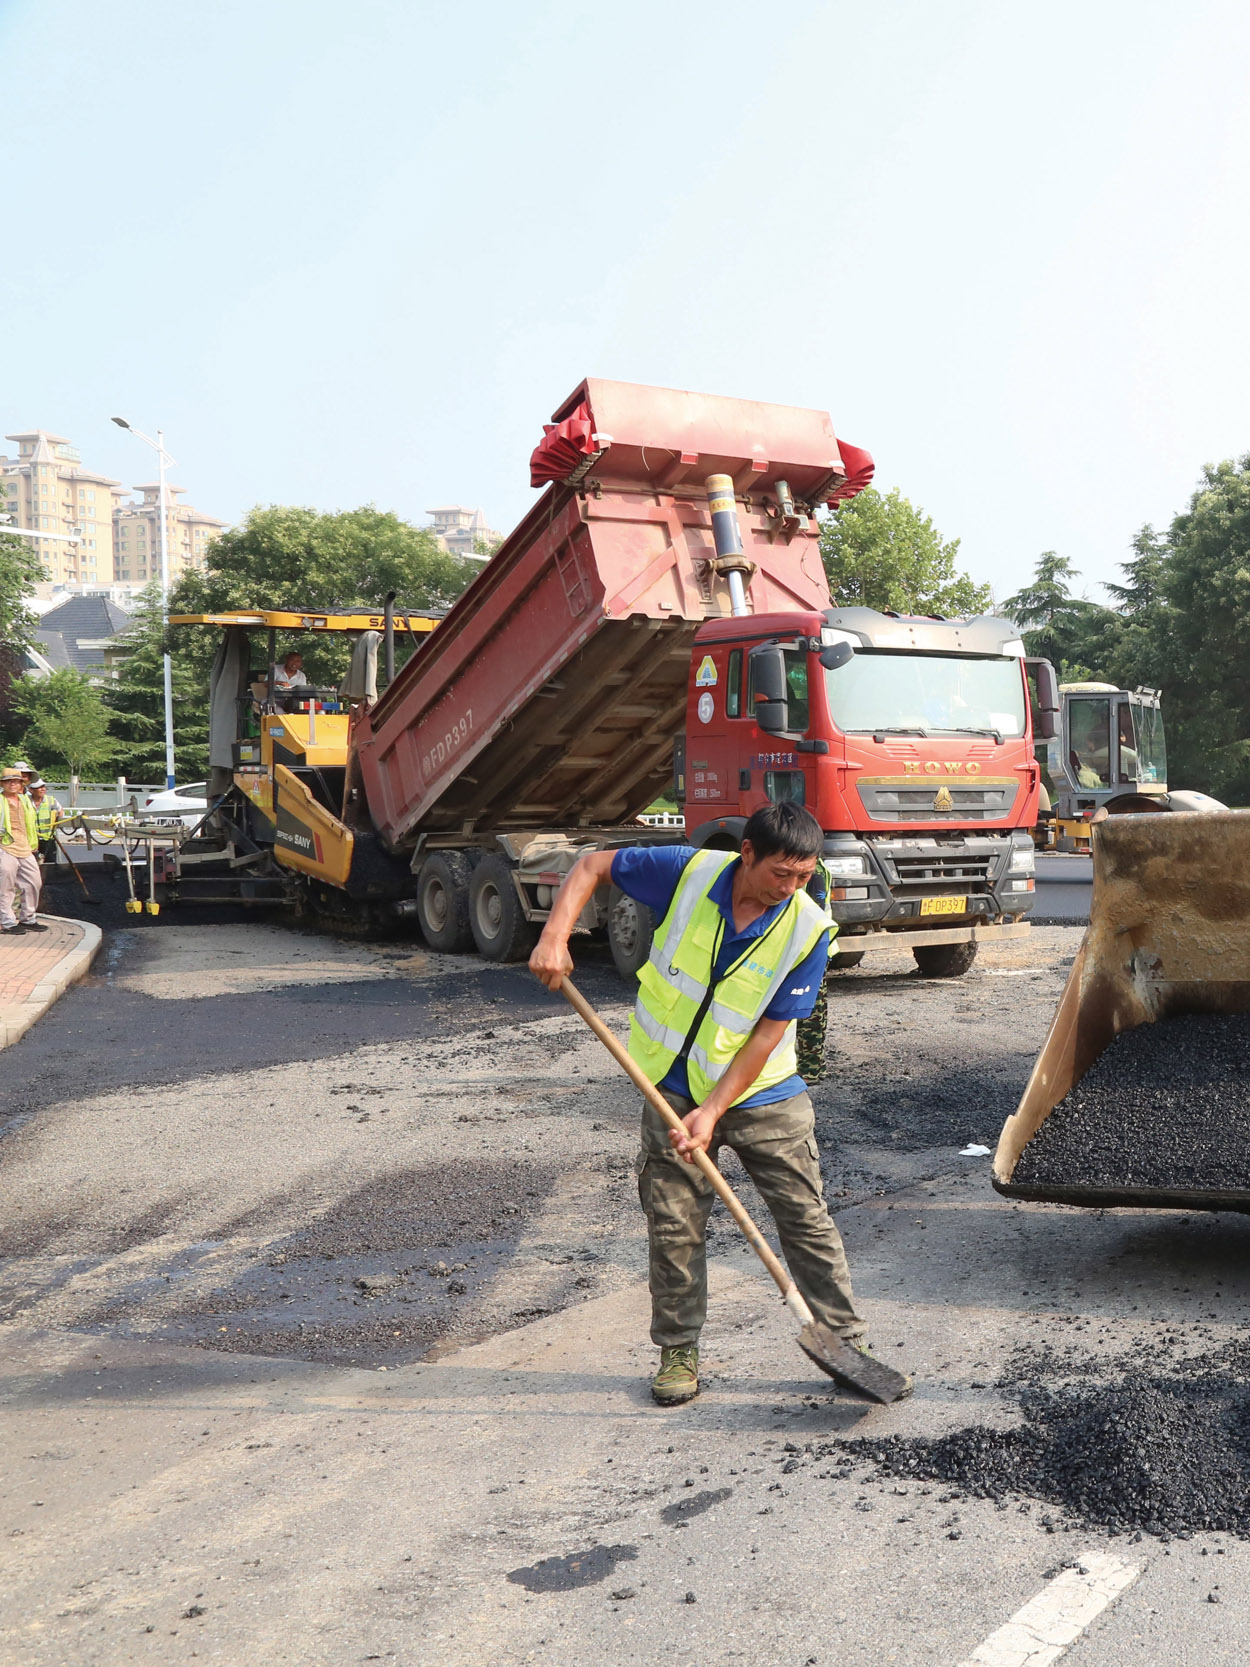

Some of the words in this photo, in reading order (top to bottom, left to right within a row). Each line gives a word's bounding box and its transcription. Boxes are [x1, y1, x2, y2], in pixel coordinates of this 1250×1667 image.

[701, 697, 711, 719] 5
[903, 761, 981, 774] HOWO
[294, 833, 311, 849] SANY
